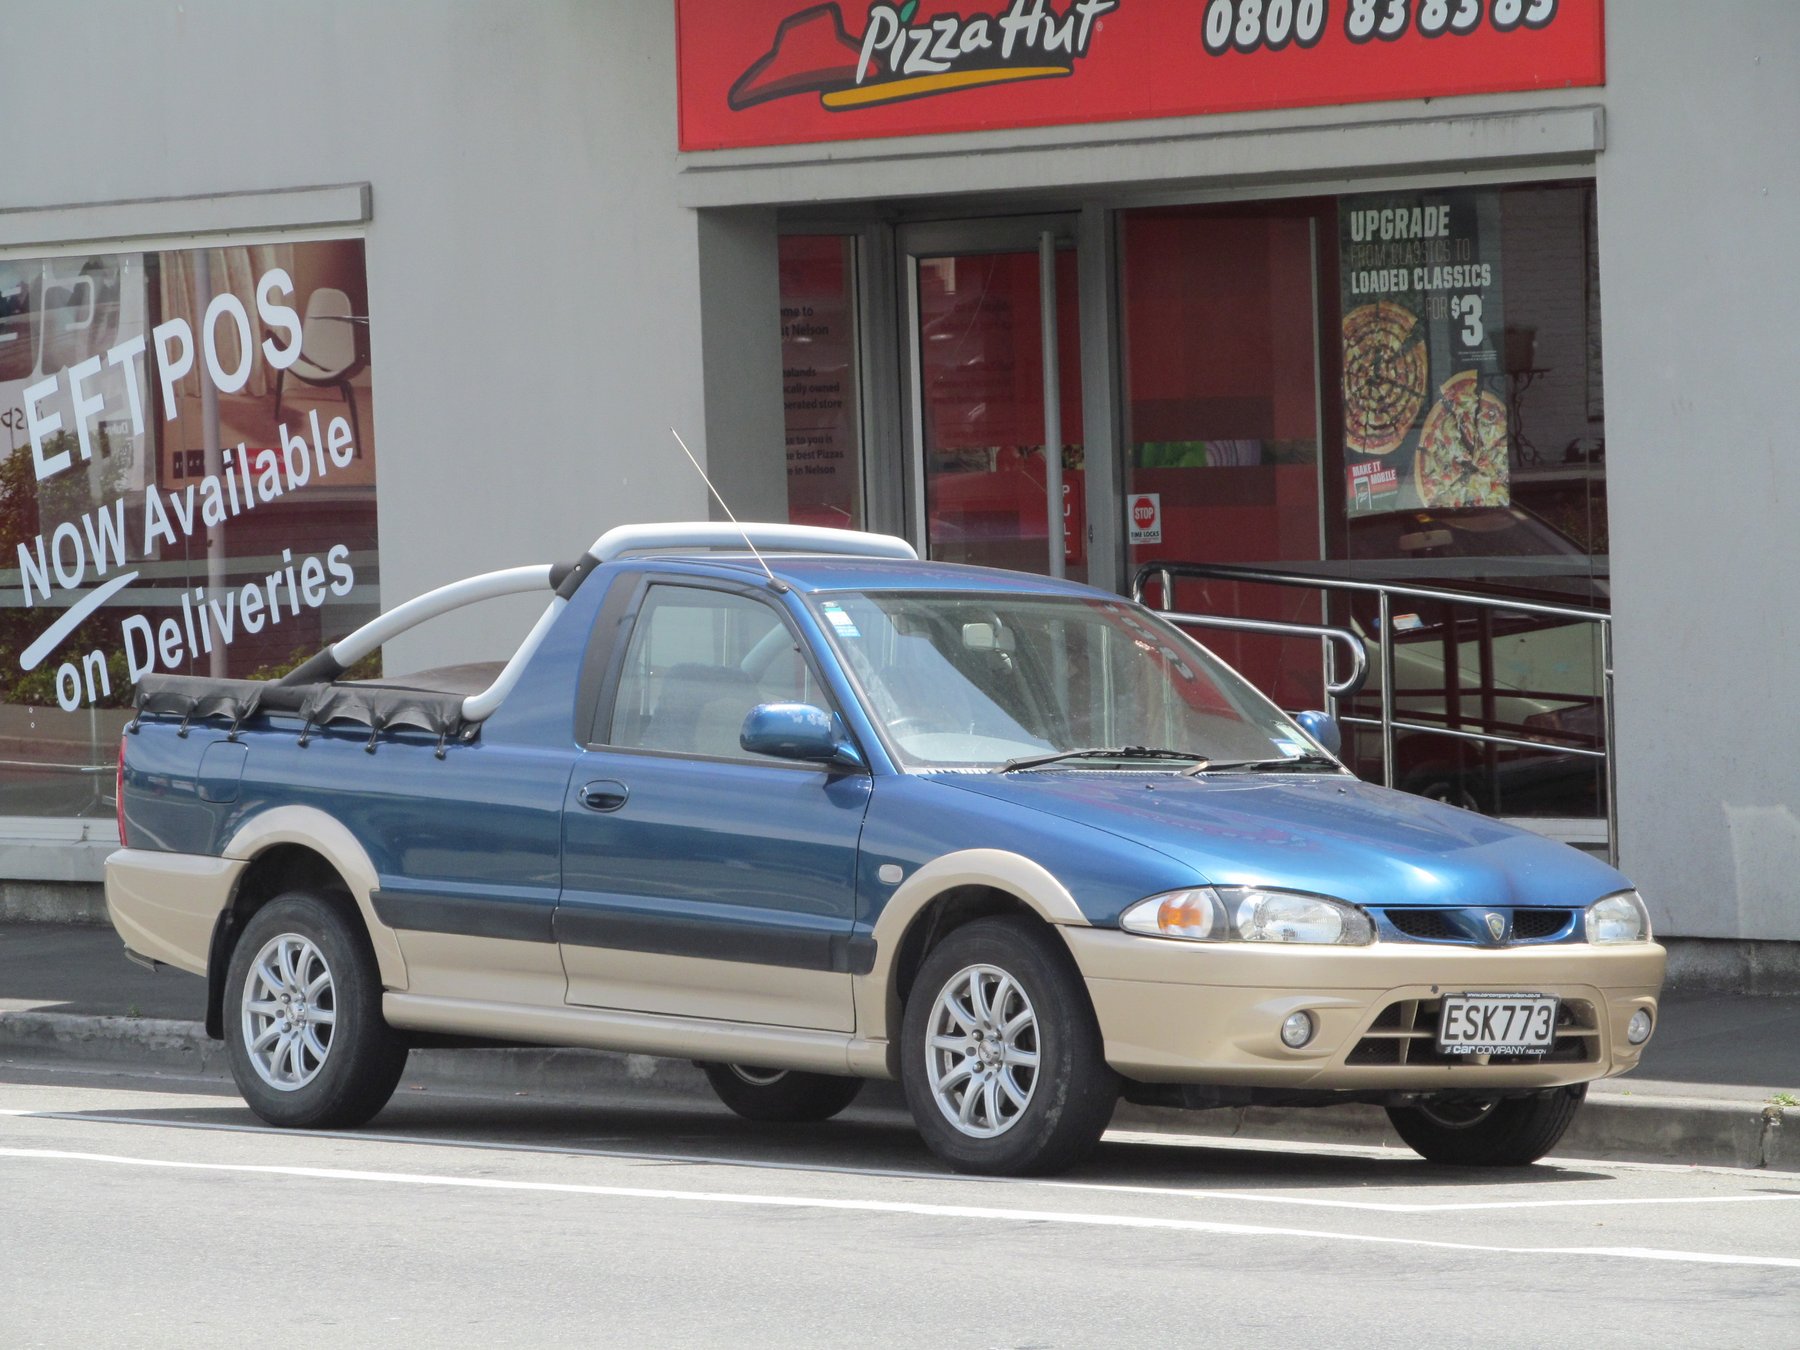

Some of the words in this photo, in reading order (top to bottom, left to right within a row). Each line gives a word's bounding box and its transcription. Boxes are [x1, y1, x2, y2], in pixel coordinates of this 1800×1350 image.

[1206, 0, 1324, 48] 0800
[857, 0, 992, 84] Pizza
[1000, 0, 1114, 58] Hut
[1351, 205, 1450, 241] UPGRADE
[1352, 243, 1386, 268] FROM
[1391, 240, 1450, 265] CLASSICS
[1456, 238, 1471, 261] TO
[1352, 268, 1409, 294] LOADED
[1414, 263, 1491, 290] CLASSICS
[1426, 296, 1449, 320] FOR
[791, 323, 829, 336] Nelson
[22, 267, 304, 482] EFTPOS
[796, 449, 815, 461] best
[816, 448, 845, 460] Pizzas
[804, 464, 836, 475] Nelson
[17, 497, 128, 608] NOW
[144, 408, 354, 555] Available
[1134, 507, 1154, 520] STOP
[56, 648, 111, 712] on
[121, 543, 355, 684] Deliveries
[1444, 1005, 1552, 1041] ESK773
[1453, 1045, 1476, 1054] car
[1476, 1045, 1527, 1054] COMPANY
